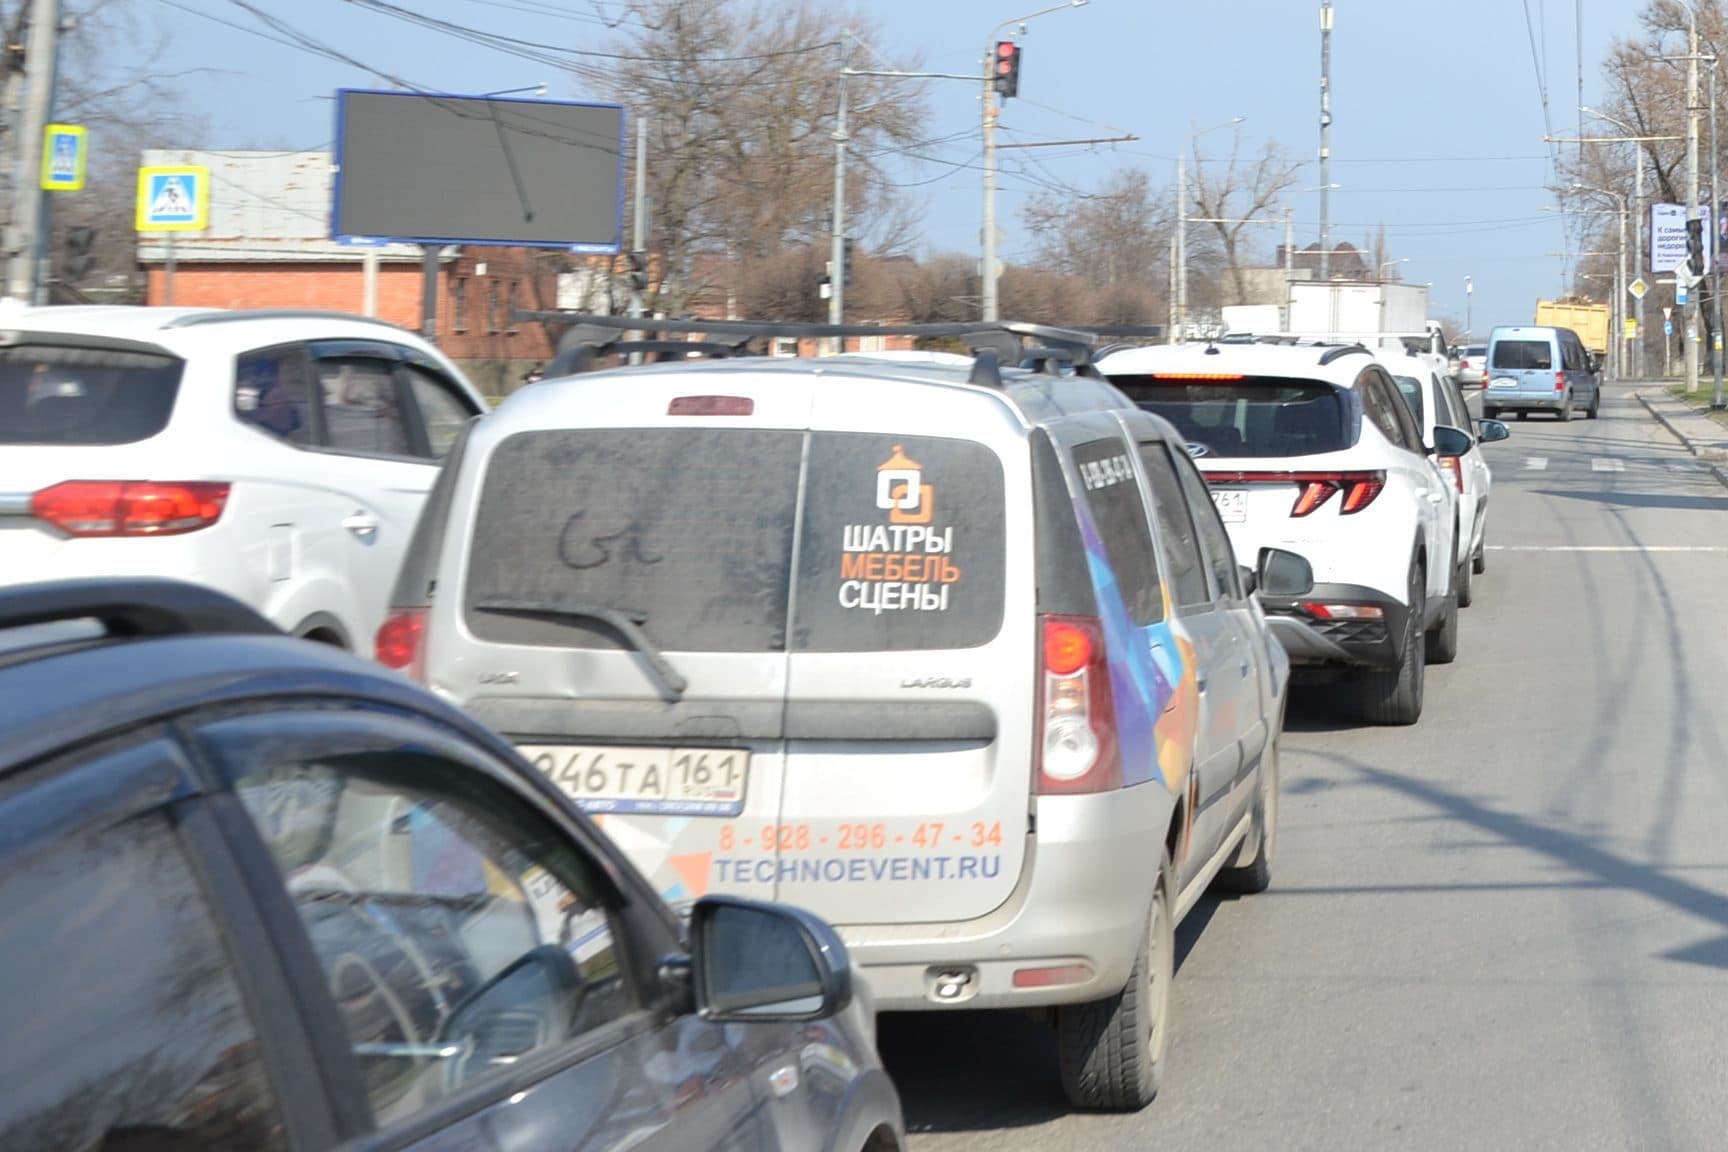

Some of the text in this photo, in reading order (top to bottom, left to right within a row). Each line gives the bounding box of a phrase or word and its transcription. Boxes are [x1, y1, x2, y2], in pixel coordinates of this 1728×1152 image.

[842, 524, 953, 553] ШАТРЫ
[840, 552, 961, 583] МЕБЕЛЬ
[838, 580, 949, 616] СЦЕНЫ
[674, 753, 736, 786] 161
[714, 854, 1001, 883] TECHNOEVENT.RU
